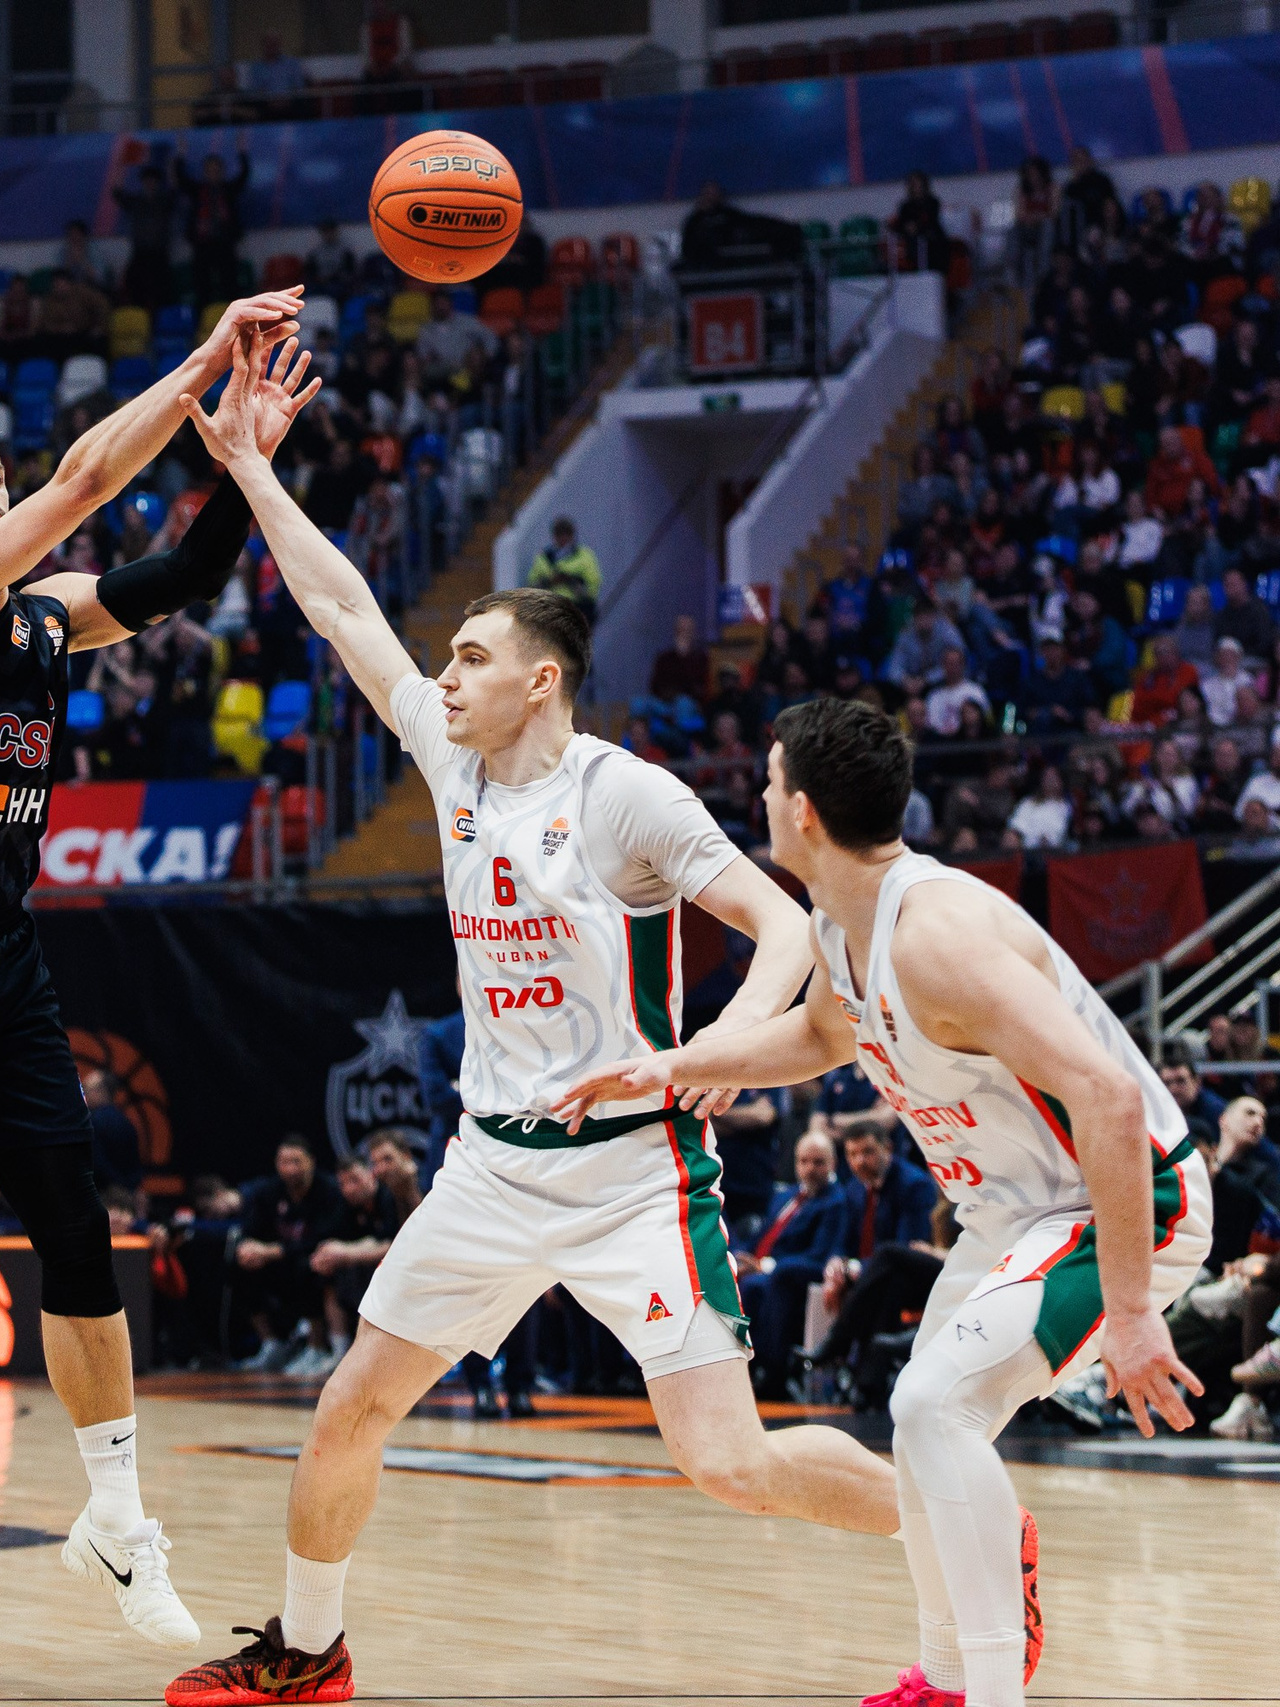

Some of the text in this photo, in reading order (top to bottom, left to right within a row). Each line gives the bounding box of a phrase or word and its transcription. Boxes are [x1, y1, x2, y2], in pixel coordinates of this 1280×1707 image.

[409, 155, 507, 181] JÖGEL
[430, 209, 501, 227] WINLINE
[543, 830, 570, 841] WINLINE
[541, 839, 565, 850] BASKET
[543, 848, 556, 857] CUP
[346, 1081, 433, 1126] ЦСК
